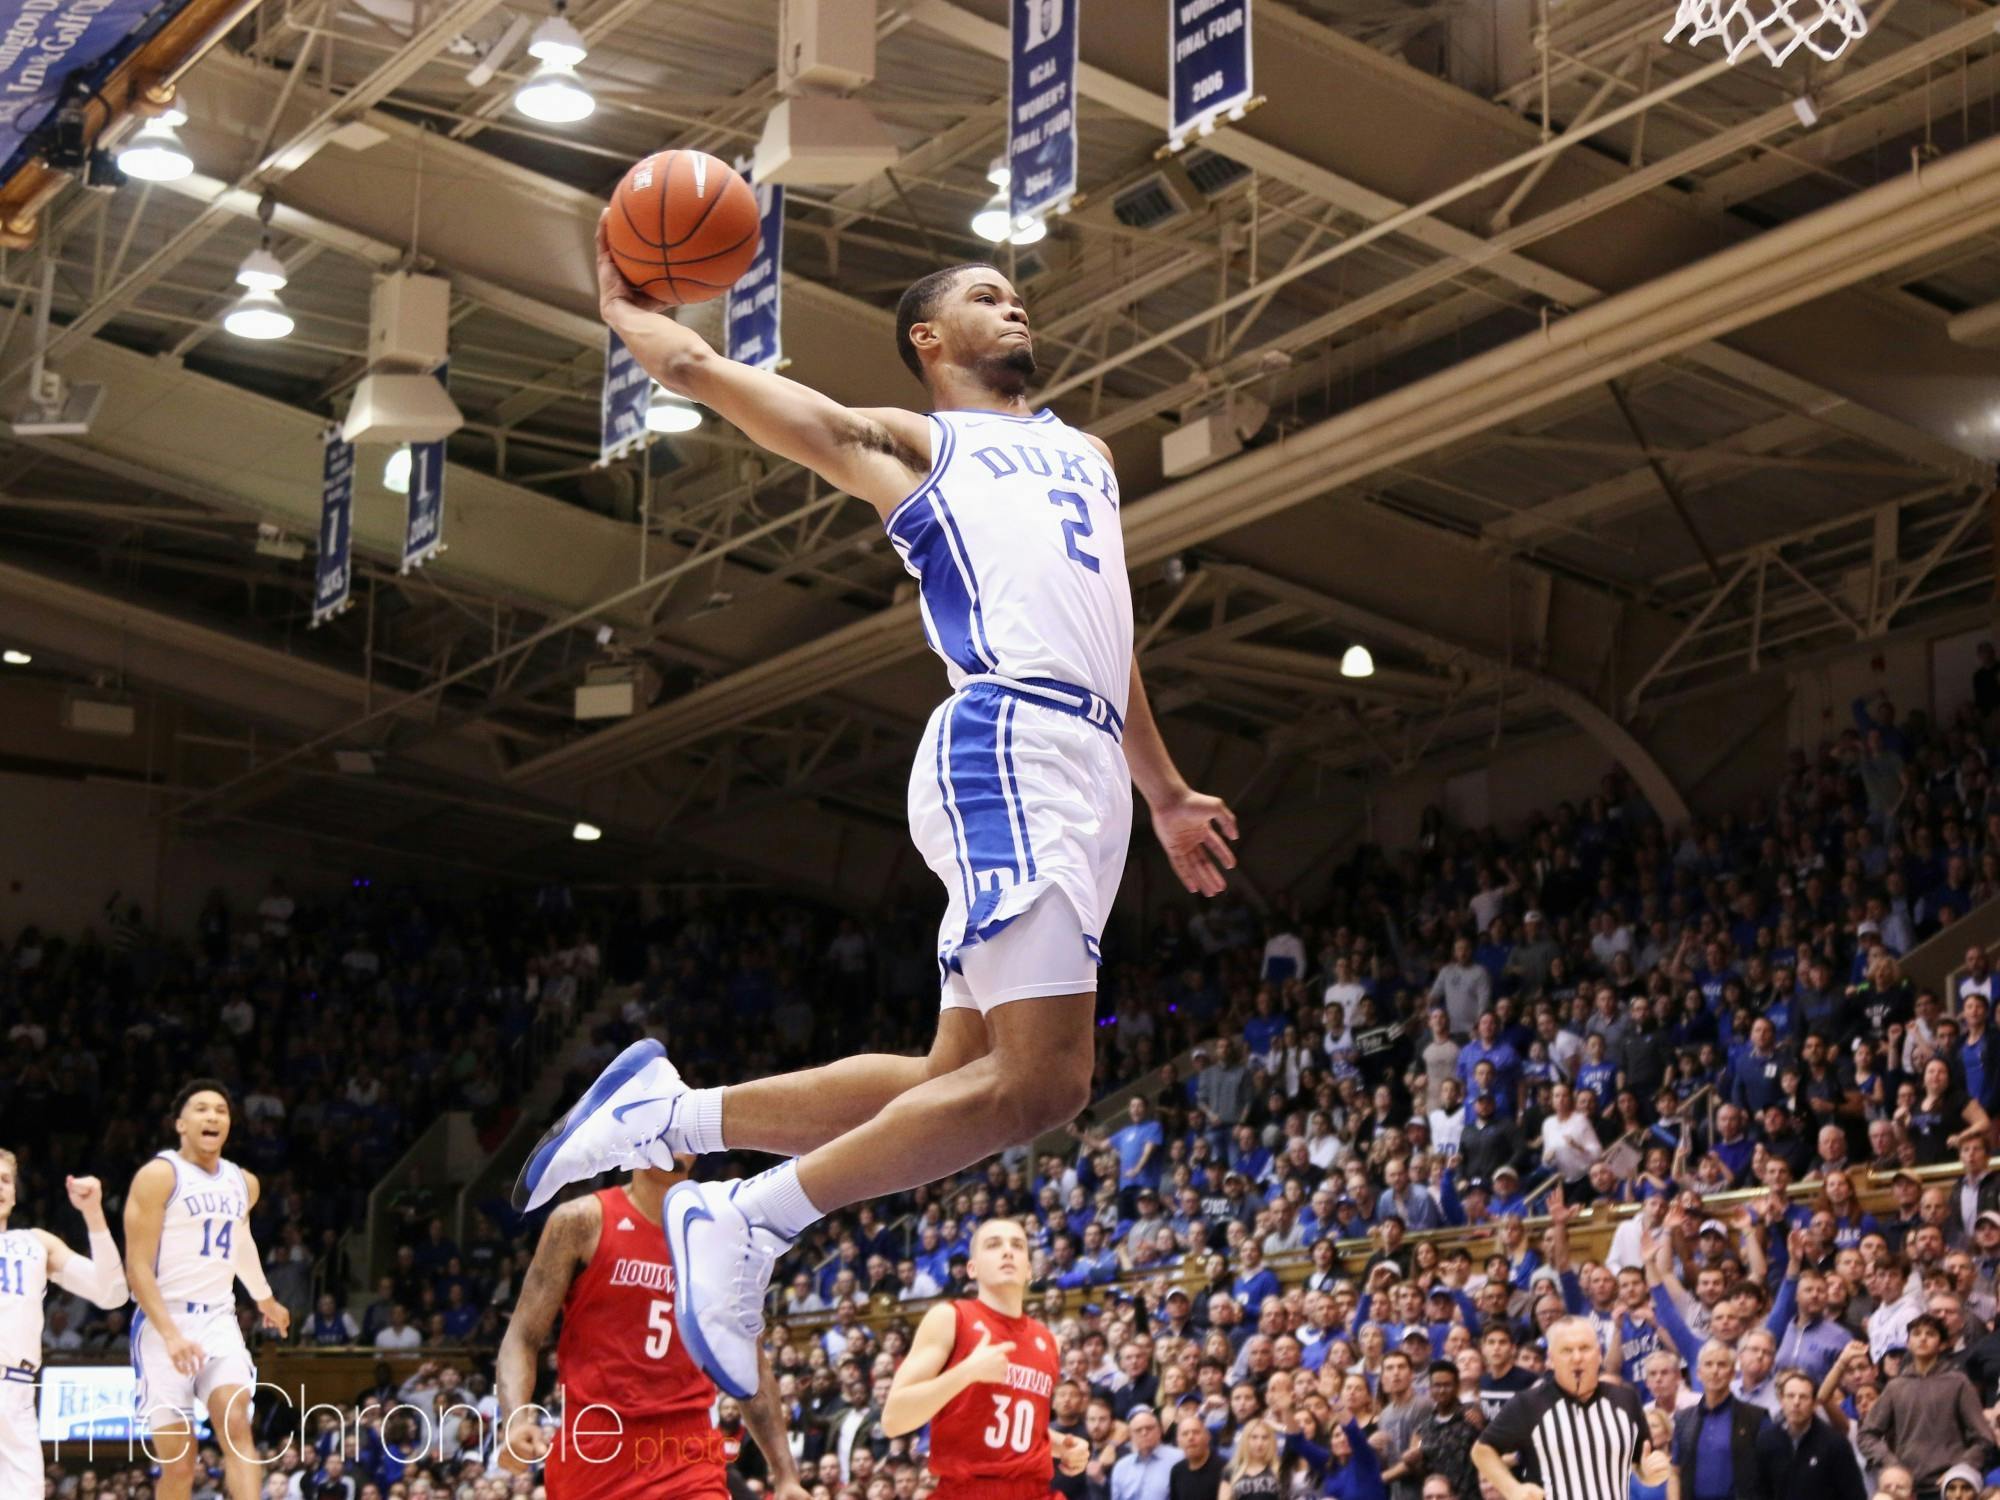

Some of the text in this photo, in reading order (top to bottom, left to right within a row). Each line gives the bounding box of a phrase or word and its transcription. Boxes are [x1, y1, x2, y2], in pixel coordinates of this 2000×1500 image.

[39, 12, 94, 51] Golf
[1177, 7, 1243, 63] FINAL FOUR
[1047, 488, 1101, 575] 2
[199, 1218, 234, 1260] 14
[644, 1299, 674, 1360] 5
[983, 1393, 1035, 1453] 30
